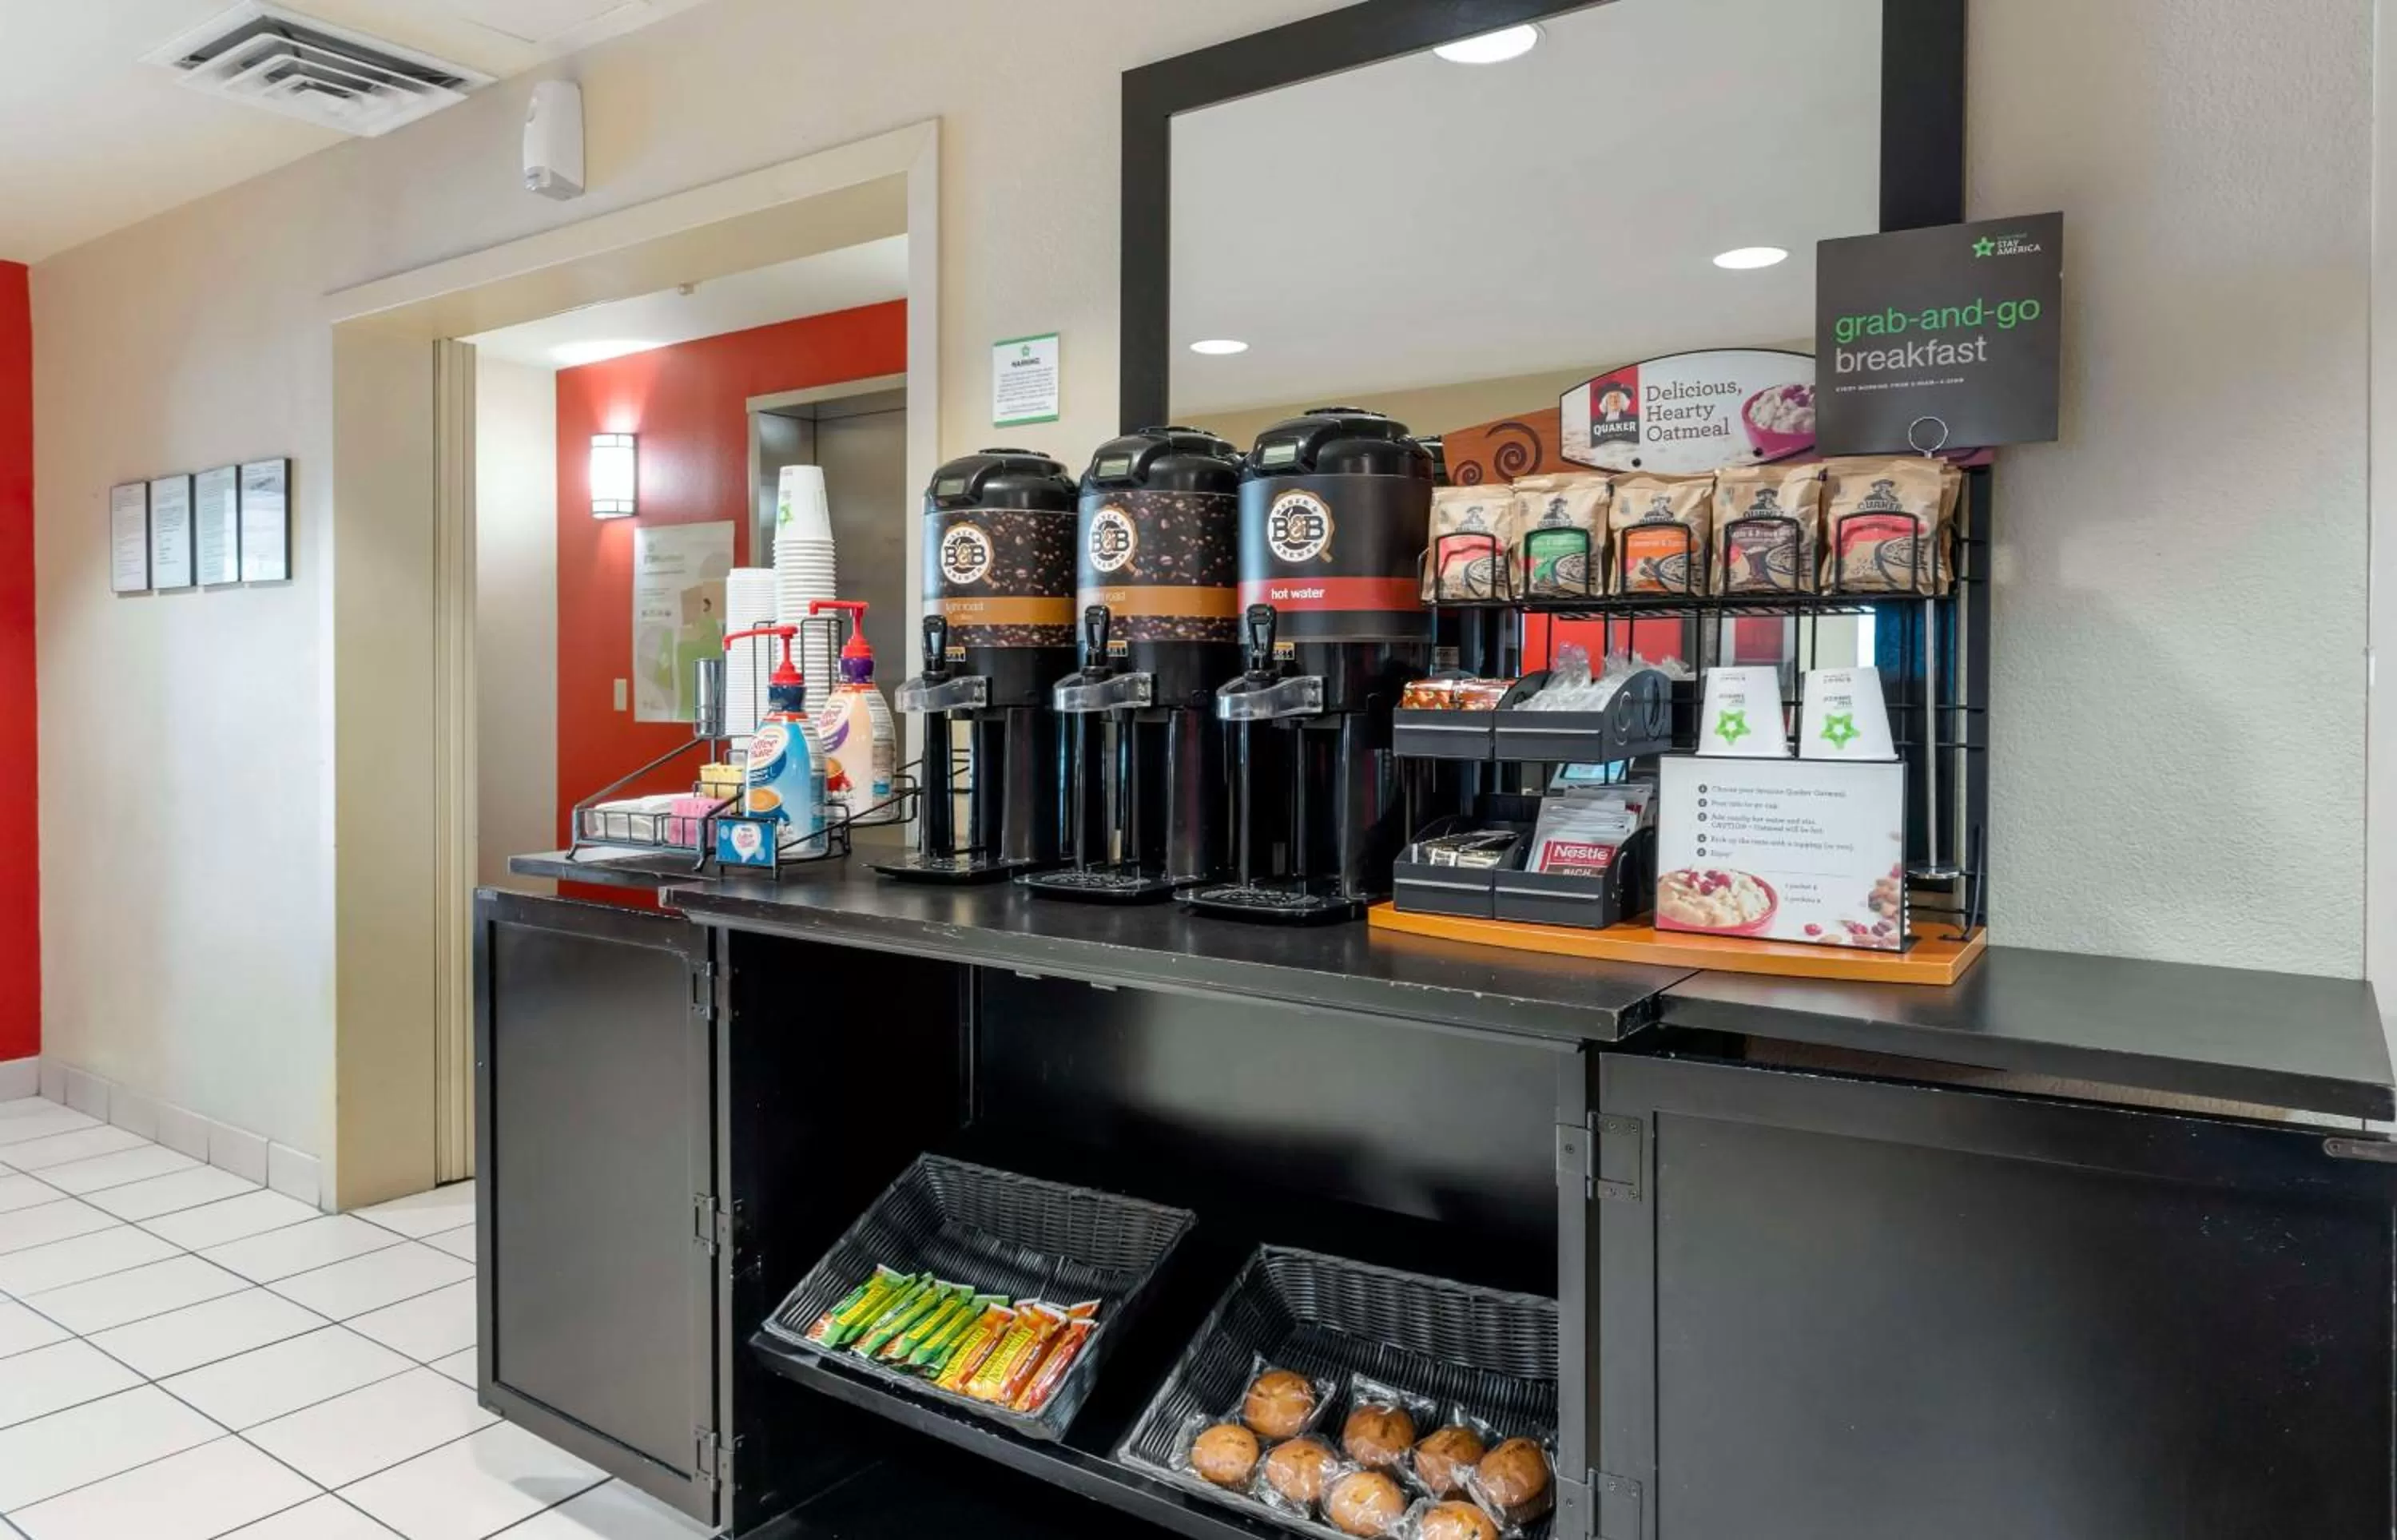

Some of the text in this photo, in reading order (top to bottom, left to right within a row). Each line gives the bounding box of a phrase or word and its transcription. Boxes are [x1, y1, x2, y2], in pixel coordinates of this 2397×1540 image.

[1998, 240, 2020, 249] STAY
[1998, 244, 2041, 256] AMERICA
[1835, 298, 2041, 344] grab-and-go
[1835, 334, 1988, 373] breakfast
[1646, 381, 1743, 403] Delicious,
[1646, 403, 1715, 423] Hearty
[1593, 421, 1637, 437] QUAKER
[1647, 418, 1731, 442] Oatmeal
[1271, 515, 1326, 542] B&B
[1091, 530, 1130, 554] B&B
[944, 544, 987, 566] B&B
[1271, 588, 1325, 599] hot water
